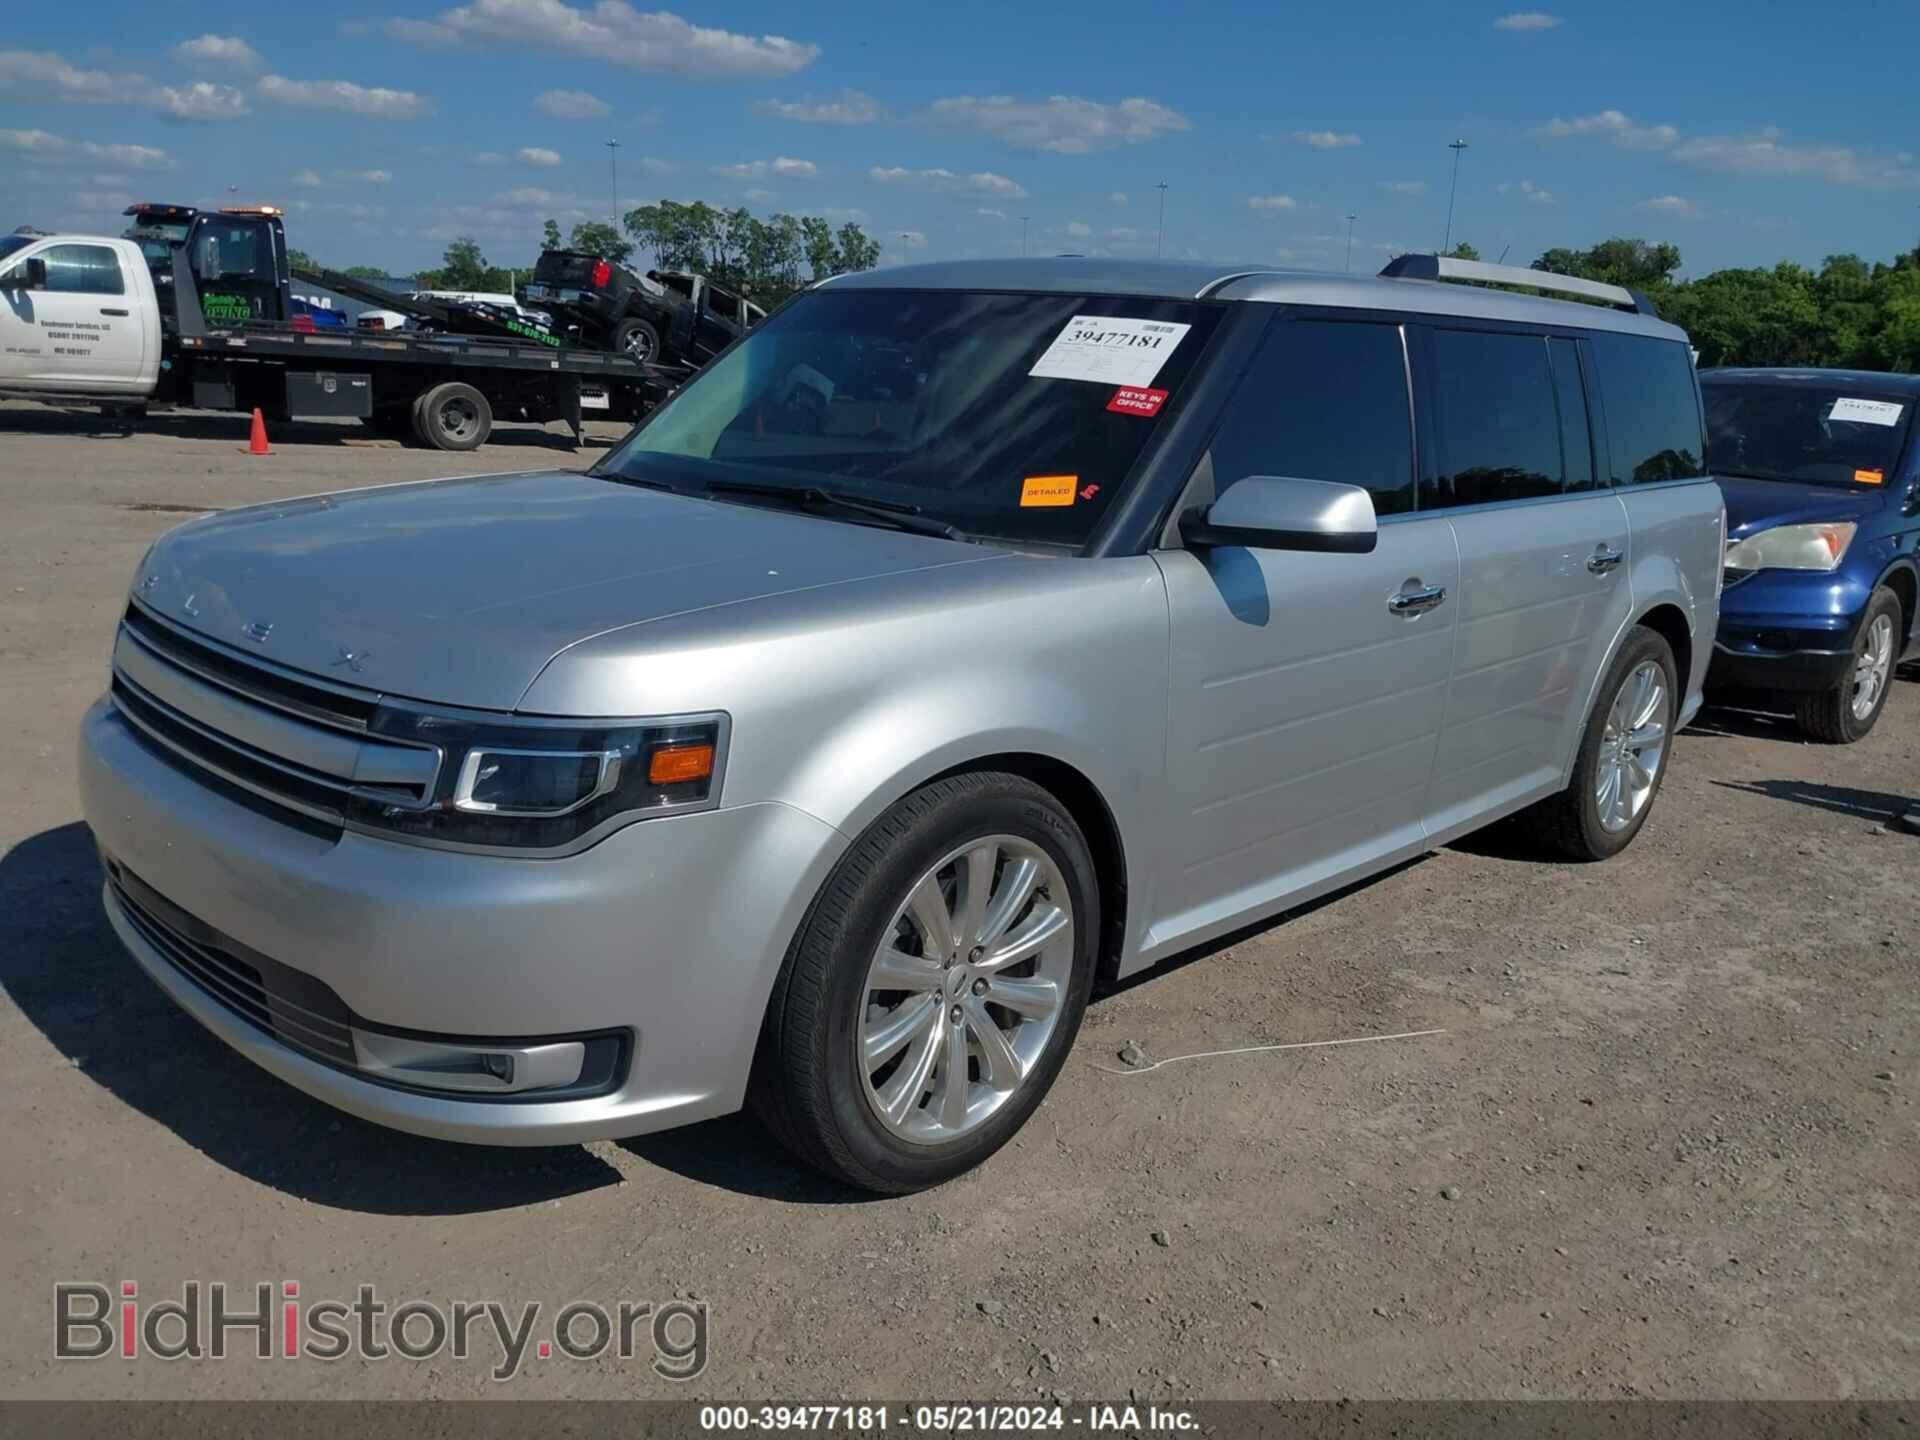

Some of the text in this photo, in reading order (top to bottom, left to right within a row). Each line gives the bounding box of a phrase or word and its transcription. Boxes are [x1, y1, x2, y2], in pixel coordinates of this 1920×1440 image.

[1068, 330, 1163, 349] 39477181
[1119, 391, 1162, 403] KEYS IN
[1116, 399, 1153, 410] OFFICE
[1027, 487, 1071, 496] DETAILED
